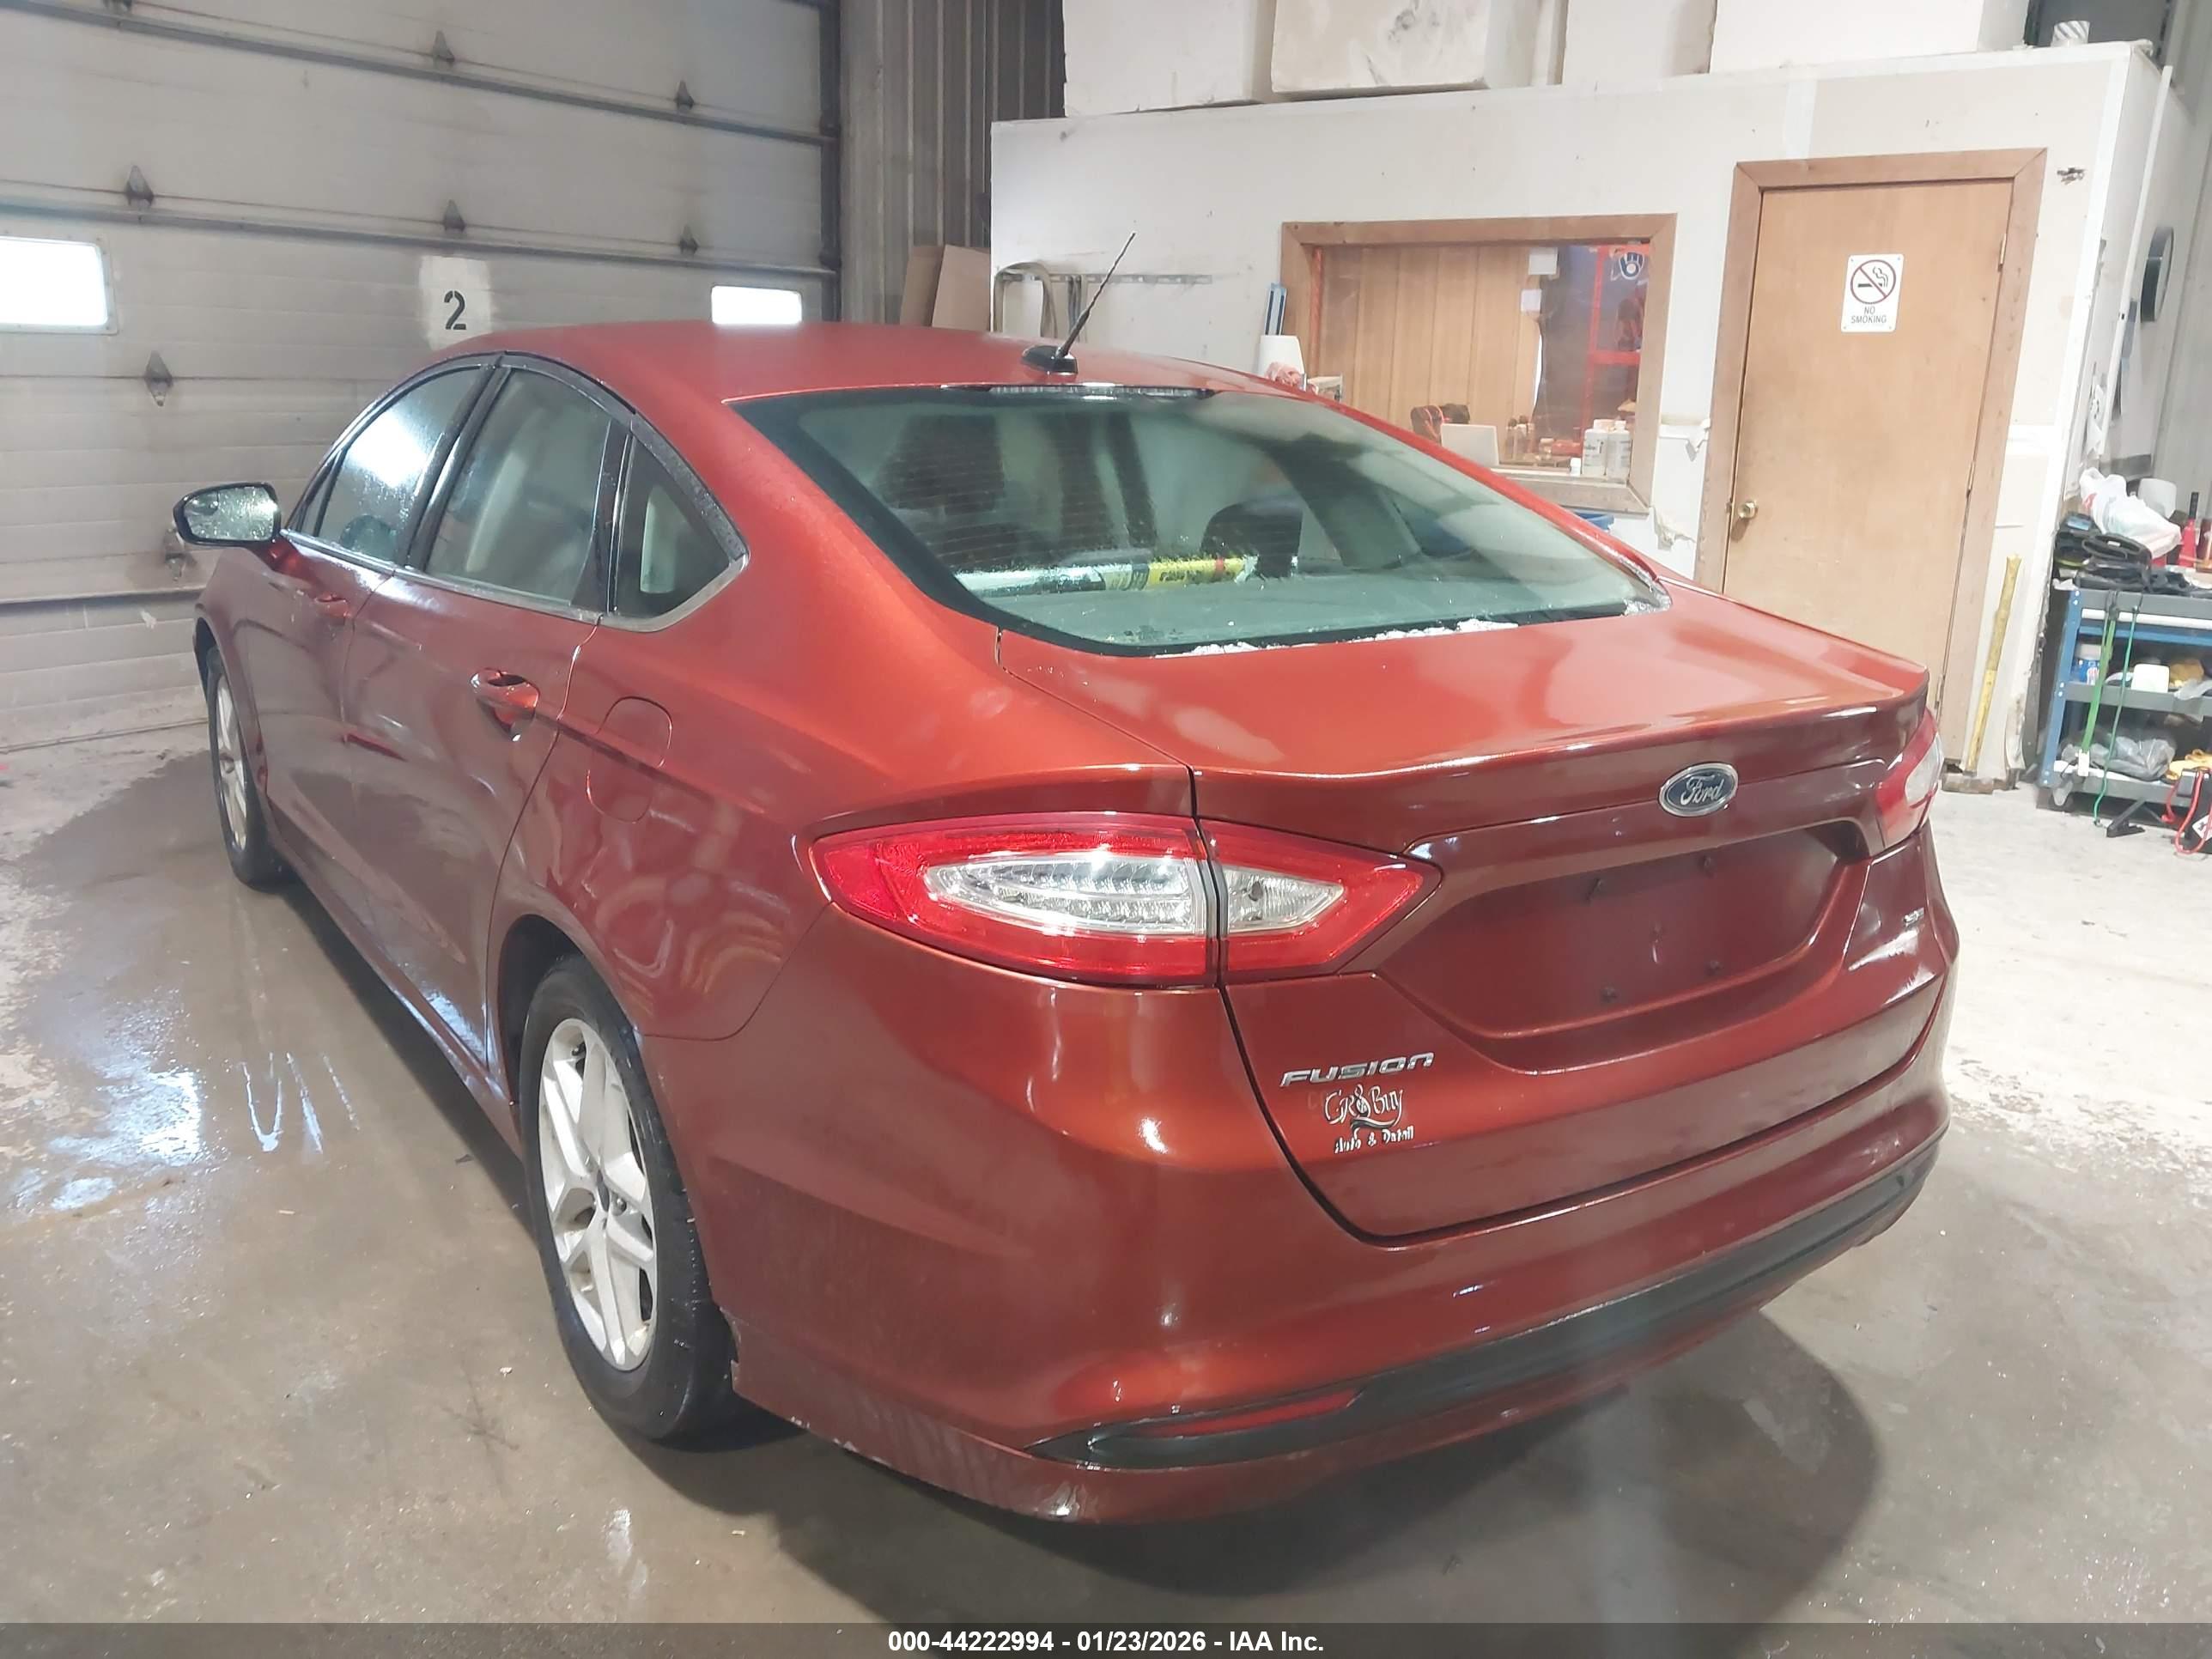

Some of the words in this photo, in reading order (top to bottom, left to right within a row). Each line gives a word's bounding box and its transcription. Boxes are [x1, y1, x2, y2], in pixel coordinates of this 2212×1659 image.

[443, 290, 467, 331] 2
[1850, 314, 1887, 324] SMOKING
[1863, 306, 1876, 315] NO
[1680, 774, 1725, 805] Ford
[1279, 1052, 1436, 1088] FUSION
[1367, 1131, 1377, 1147] &
